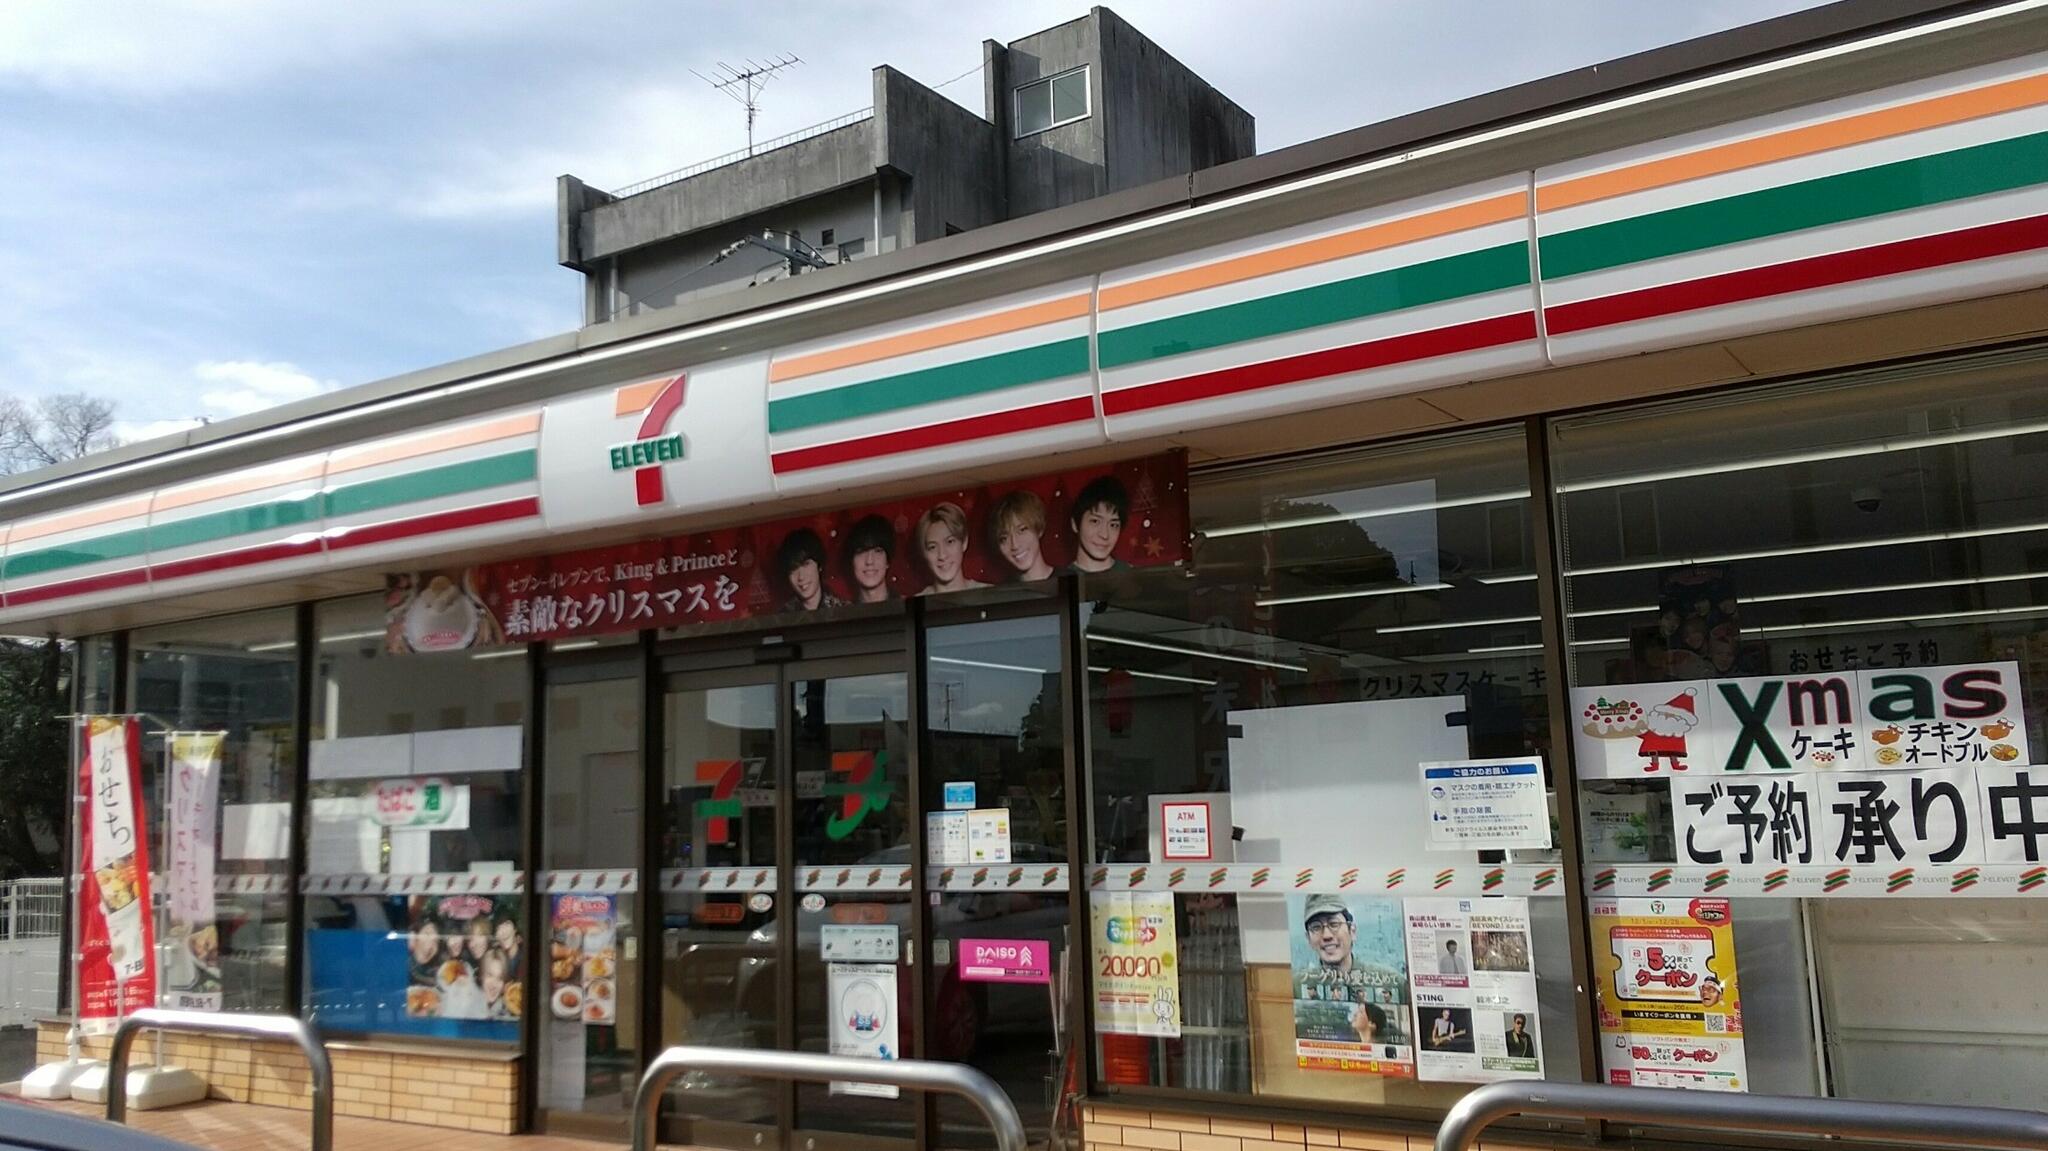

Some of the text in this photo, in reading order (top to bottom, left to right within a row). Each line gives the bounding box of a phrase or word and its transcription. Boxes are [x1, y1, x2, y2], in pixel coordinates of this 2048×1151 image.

[614, 562, 654, 582] King
[657, 560, 670, 575] &
[505, 574, 739, 637] 素敵なクリスマスを
[1790, 639, 1940, 672] おせちご予約
[1364, 667, 1546, 698] クリスマスケーキ
[1717, 669, 2008, 771] Xmas
[1908, 722, 1977, 743] チキン
[1791, 728, 1856, 760] ケーキ
[1905, 743, 1989, 764] オードブル
[1453, 766, 1510, 777] ご協力のお願い
[98, 749, 132, 845] おせち
[1177, 811, 1196, 821] ATM
[976, 946, 1017, 960] DAISO
[1635, 969, 1698, 989] クーポン
[1416, 994, 1444, 1002] STING
[1673, 1048, 1718, 1063] クーポン
